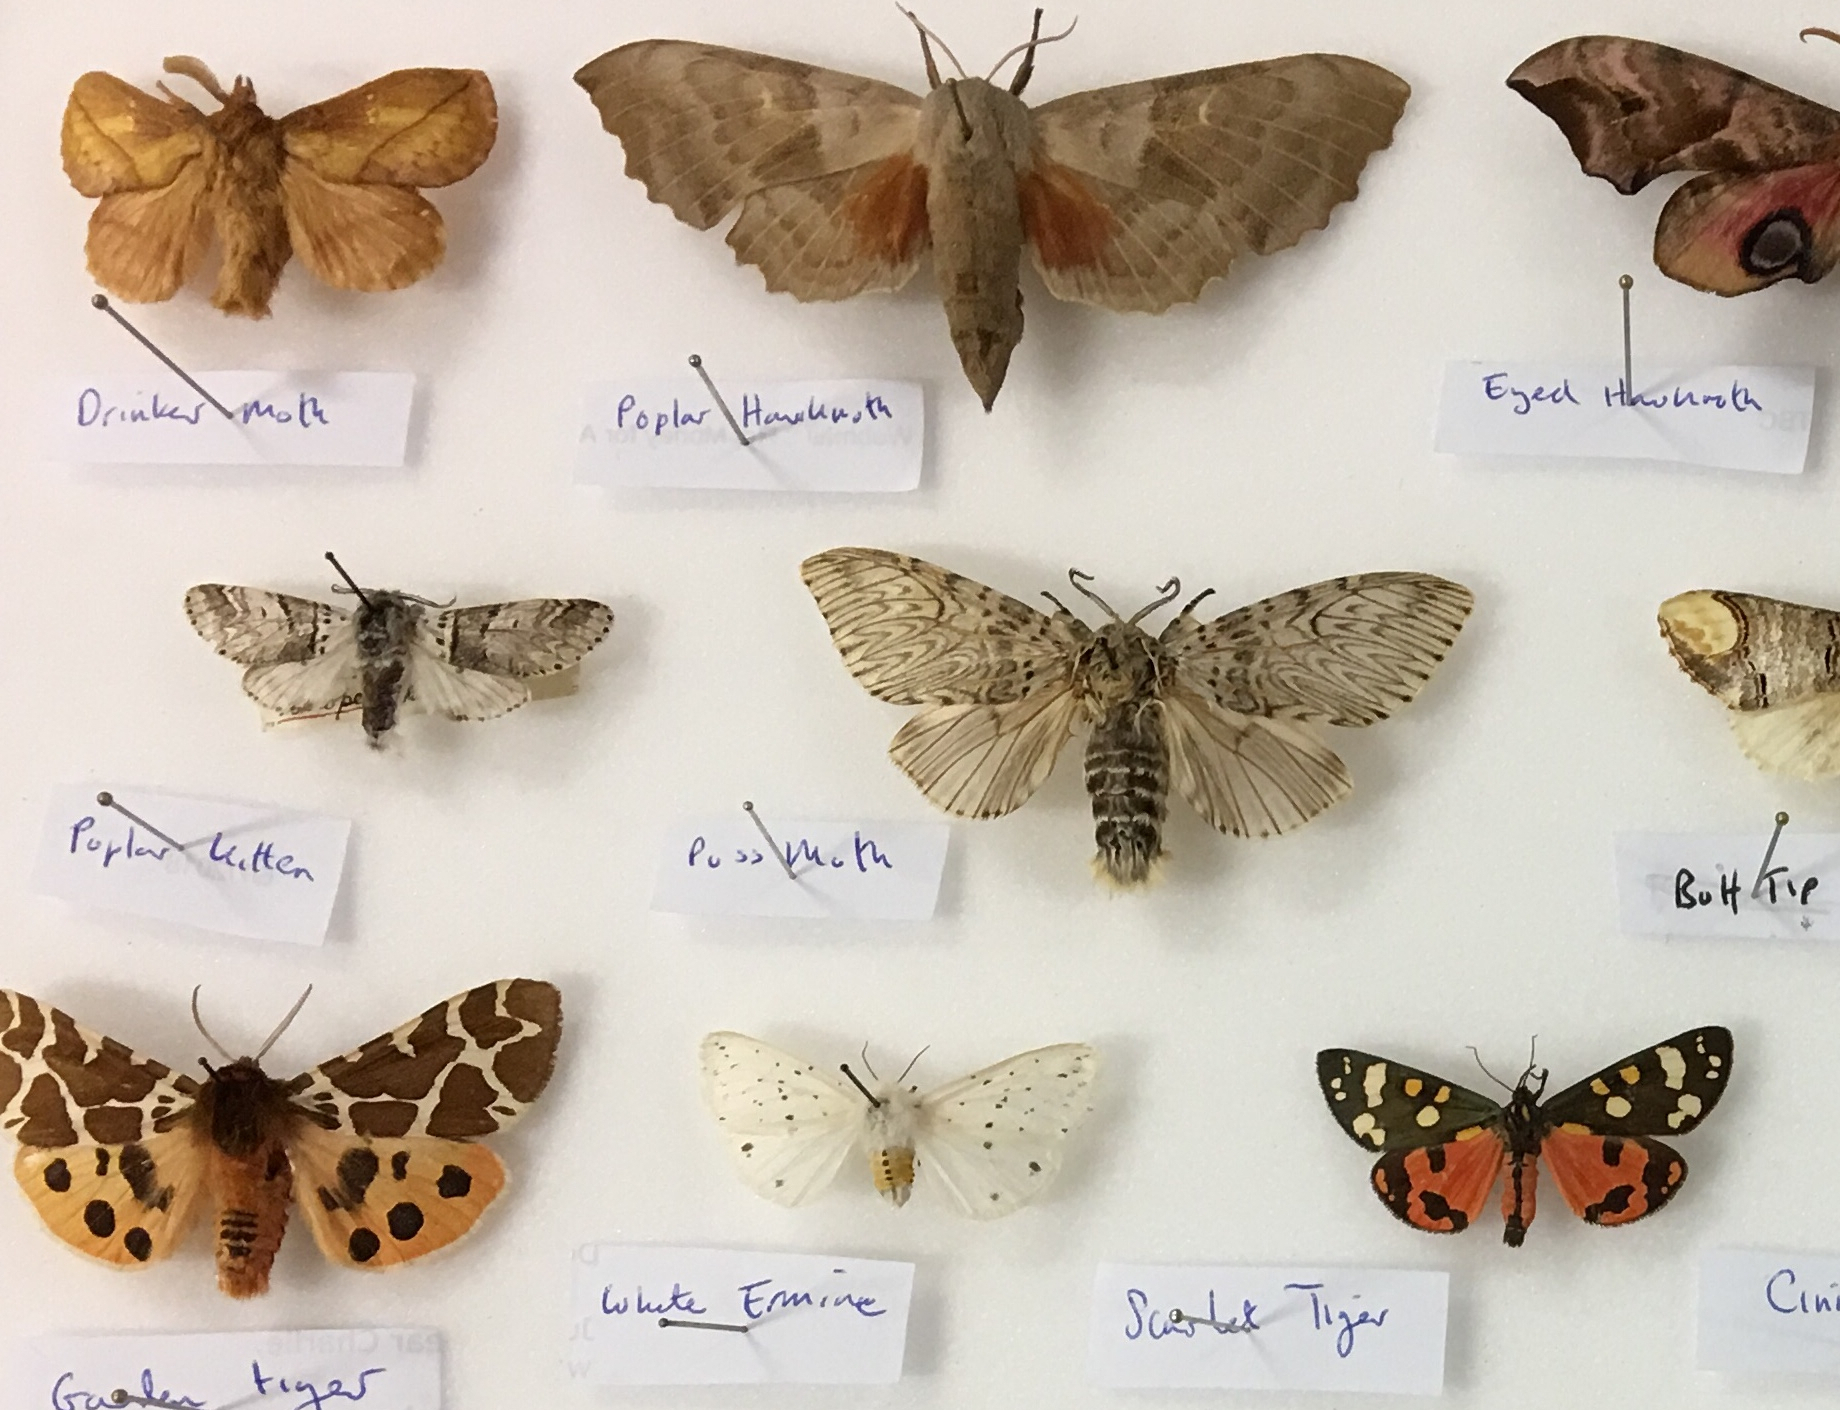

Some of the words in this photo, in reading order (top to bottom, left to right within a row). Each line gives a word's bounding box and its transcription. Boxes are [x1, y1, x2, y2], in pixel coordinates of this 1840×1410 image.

[78, 387, 206, 427] Drinker
[617, 394, 712, 436] Poplar
[1481, 372, 1582, 415] Eyed
[69, 816, 170, 867] Poplar
[687, 836, 764, 870] Puss
[601, 1283, 706, 1315] White
[738, 1269, 887, 1319] Ermine
[1283, 1281, 1389, 1357] Tiger
